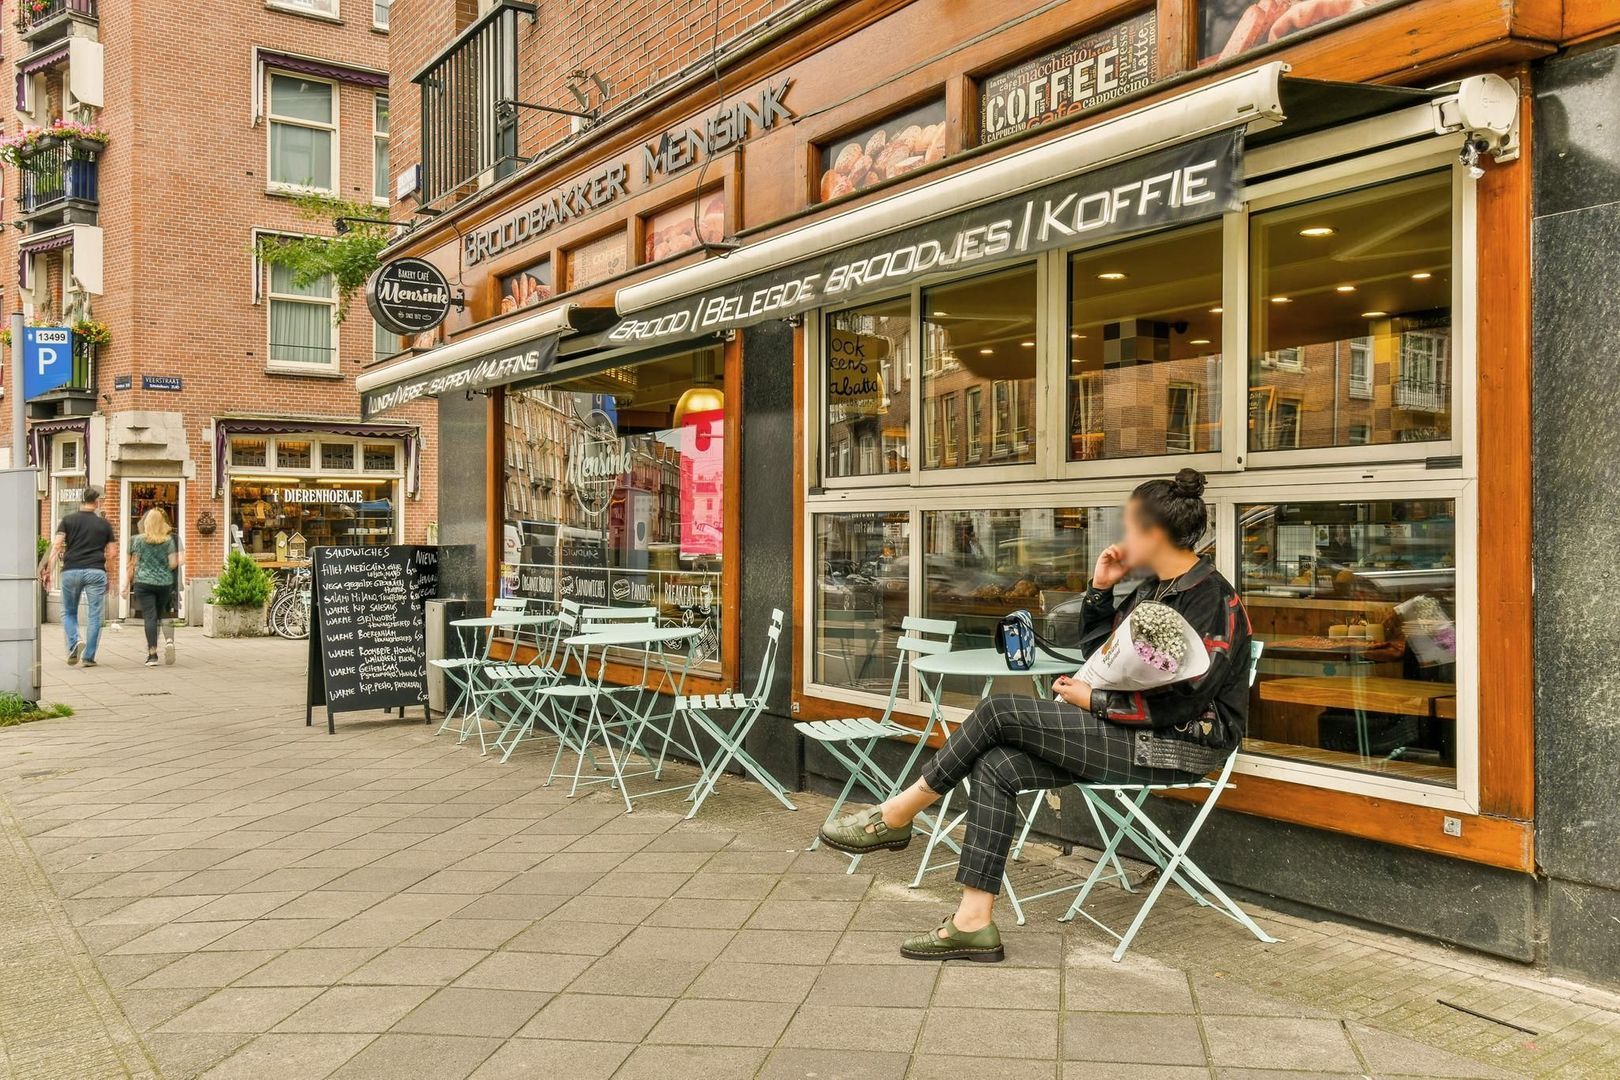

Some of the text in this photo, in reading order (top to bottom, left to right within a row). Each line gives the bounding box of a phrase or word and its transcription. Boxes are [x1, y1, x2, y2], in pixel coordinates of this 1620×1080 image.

[1119, 26, 1131, 85] espresso
[1128, 27, 1149, 79] latte
[1017, 49, 1088, 86] macchiato
[986, 47, 1119, 133] COFFEE
[1083, 76, 1149, 109] cappuccino
[987, 121, 1027, 142] CAPPUCCINO
[464, 77, 793, 267] BROODBAKKER MENSINK
[379, 281, 449, 305] Mensink
[38, 333, 66, 341] 13499
[38, 347, 57, 375] P
[284, 489, 363, 503] DIERENHOEKJE
[664, 581, 698, 606] BREAKFAST
[325, 605, 350, 616] WARME
[326, 616, 353, 626] WARME
[326, 631, 354, 642] WARME
[328, 649, 355, 658] WARME
[329, 666, 356, 677] WARME
[329, 688, 356, 701] WARME
